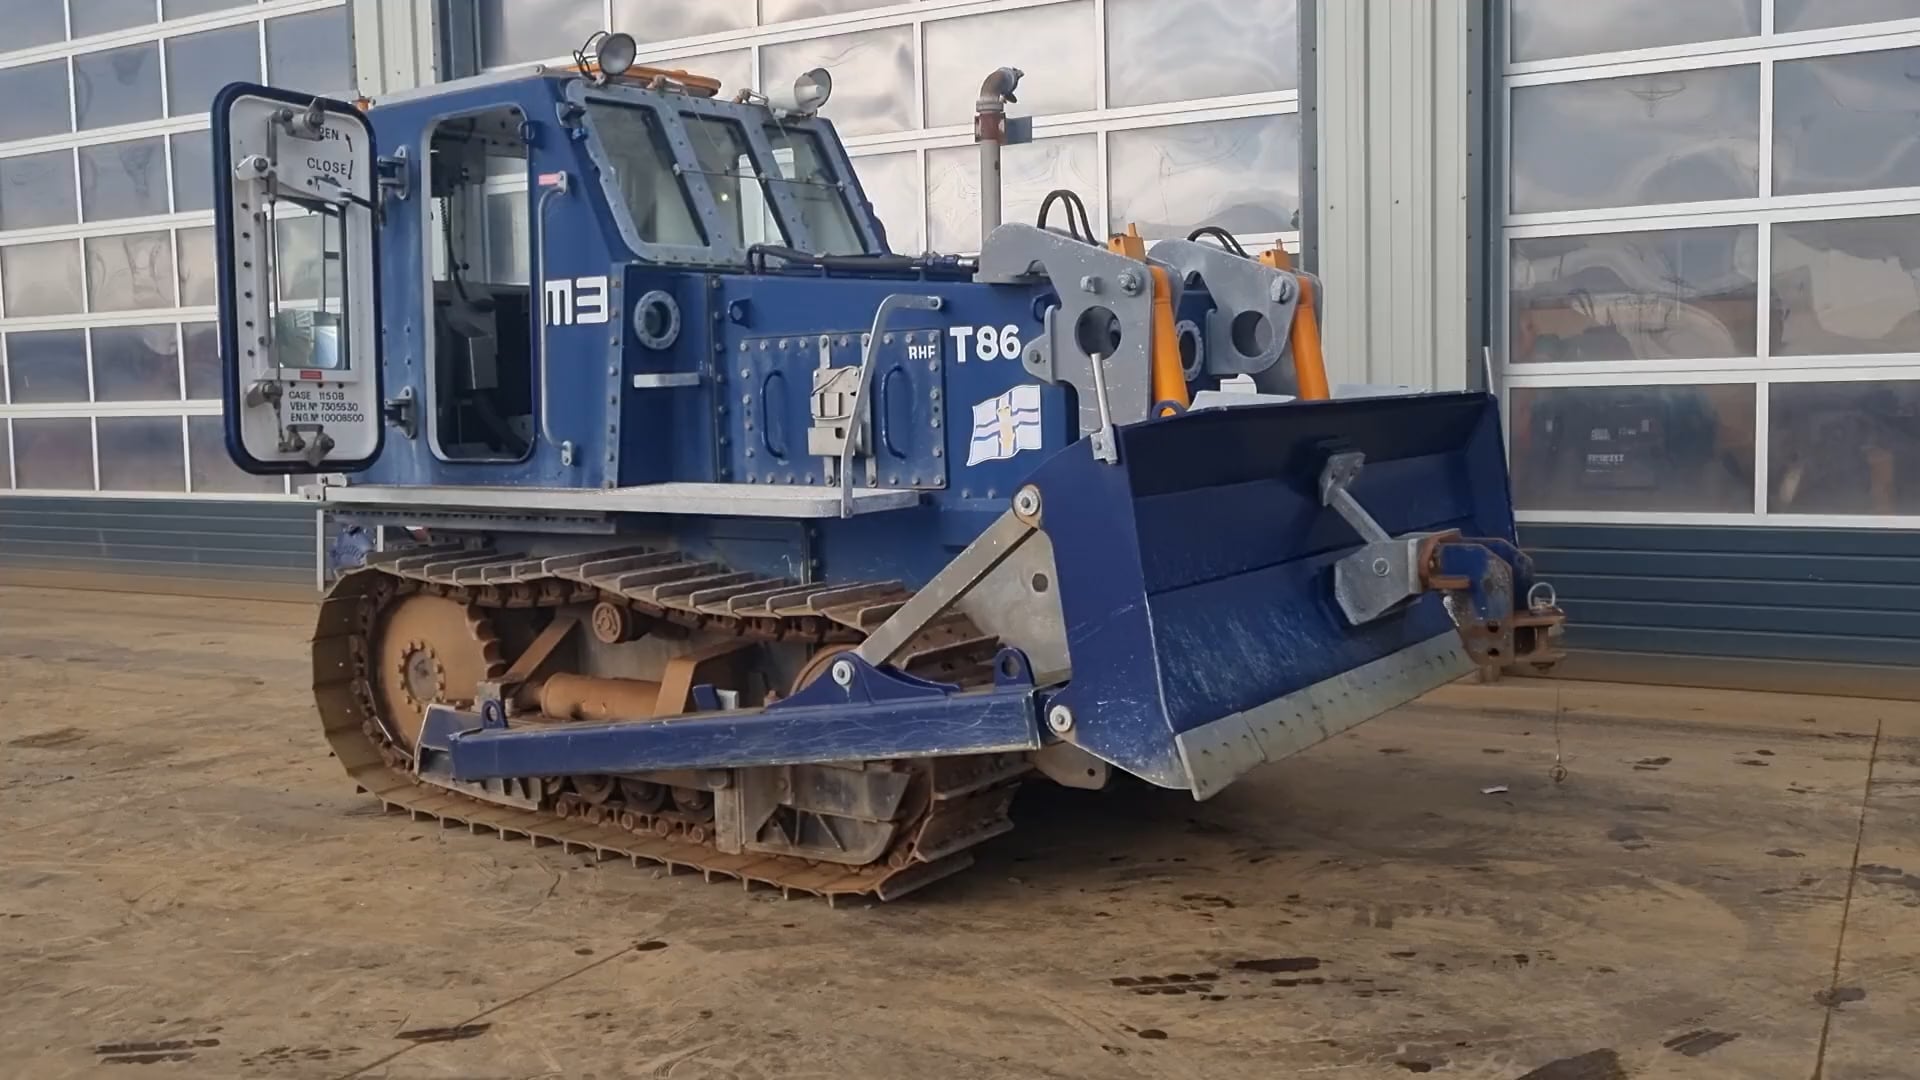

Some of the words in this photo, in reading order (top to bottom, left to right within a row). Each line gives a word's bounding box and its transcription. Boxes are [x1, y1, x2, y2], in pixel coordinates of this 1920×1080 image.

[306, 157, 347, 176] CLOSE
[545, 276, 608, 326] M3
[908, 345, 936, 360] RHF
[949, 324, 1021, 363] T86
[288, 391, 312, 401] CASE
[319, 391, 345, 401] 1150B
